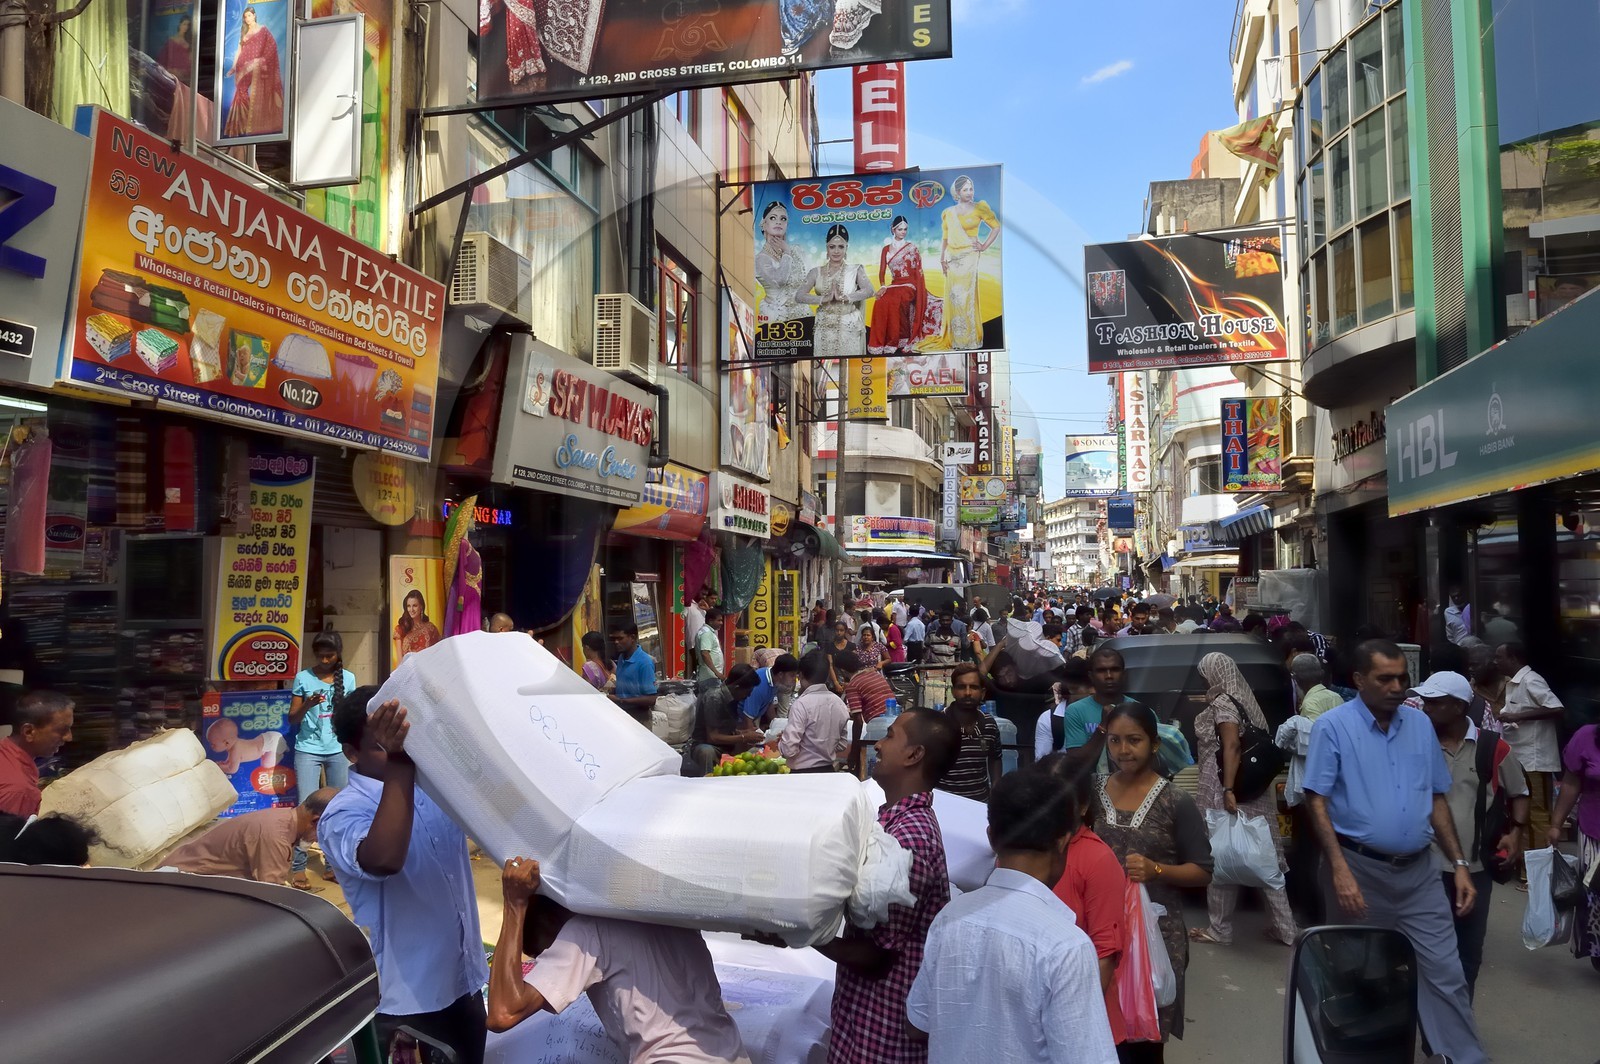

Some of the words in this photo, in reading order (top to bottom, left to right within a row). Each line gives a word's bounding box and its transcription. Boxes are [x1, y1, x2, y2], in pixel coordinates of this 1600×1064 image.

[588, 74, 611, 87] 129,
[613, 72, 637, 84] 2ND
[639, 68, 678, 81] CROSS
[680, 63, 725, 77] STREET,
[728, 57, 787, 71] COLOMBO
[789, 54, 803, 64] 11
[112, 127, 176, 177] New
[161, 169, 327, 272] ANJANA
[337, 246, 437, 322] TEXTILE
[140, 255, 192, 285] Wholesale
[193, 277, 201, 288] &
[203, 279, 230, 299] Retail
[232, 290, 265, 311] Dealers
[266, 303, 274, 316] in
[276, 306, 308, 328] Textiles.
[308, 320, 344, 342] (Specialist
[345, 333, 352, 345] in
[353, 337, 366, 350] Bed
[367, 341, 388, 358] Sheets
[388, 350, 393, 359] &
[394, 353, 415, 368] Towel)
[758, 321, 803, 340] 133
[757, 348, 786, 356] Colombo
[1117, 346, 1155, 356] Wholesale
[1165, 344, 1187, 353] Retail
[1189, 341, 1218, 351] Dealers
[1229, 339, 1256, 347] Textile
[1123, 360, 1135, 368] 2nd
[1135, 359, 1154, 367] Cross
[909, 368, 964, 386] GAEL
[283, 383, 319, 406] No.127
[934, 386, 963, 394] MANDIR
[94, 366, 117, 384] 2nd
[120, 374, 159, 396] Cross
[283, 412, 295, 423] TP
[305, 418, 320, 433] 011
[368, 434, 381, 446] 011
[1225, 403, 1243, 470] THAI
[1396, 408, 1458, 483] HBL
[1479, 441, 1497, 456] HABIB
[1497, 436, 1515, 452] BANK
[527, 471, 536, 479] 2ND
[536, 473, 551, 482] CROSS
[567, 479, 586, 489] COLOMBO
[946, 467, 954, 528] MESCO
